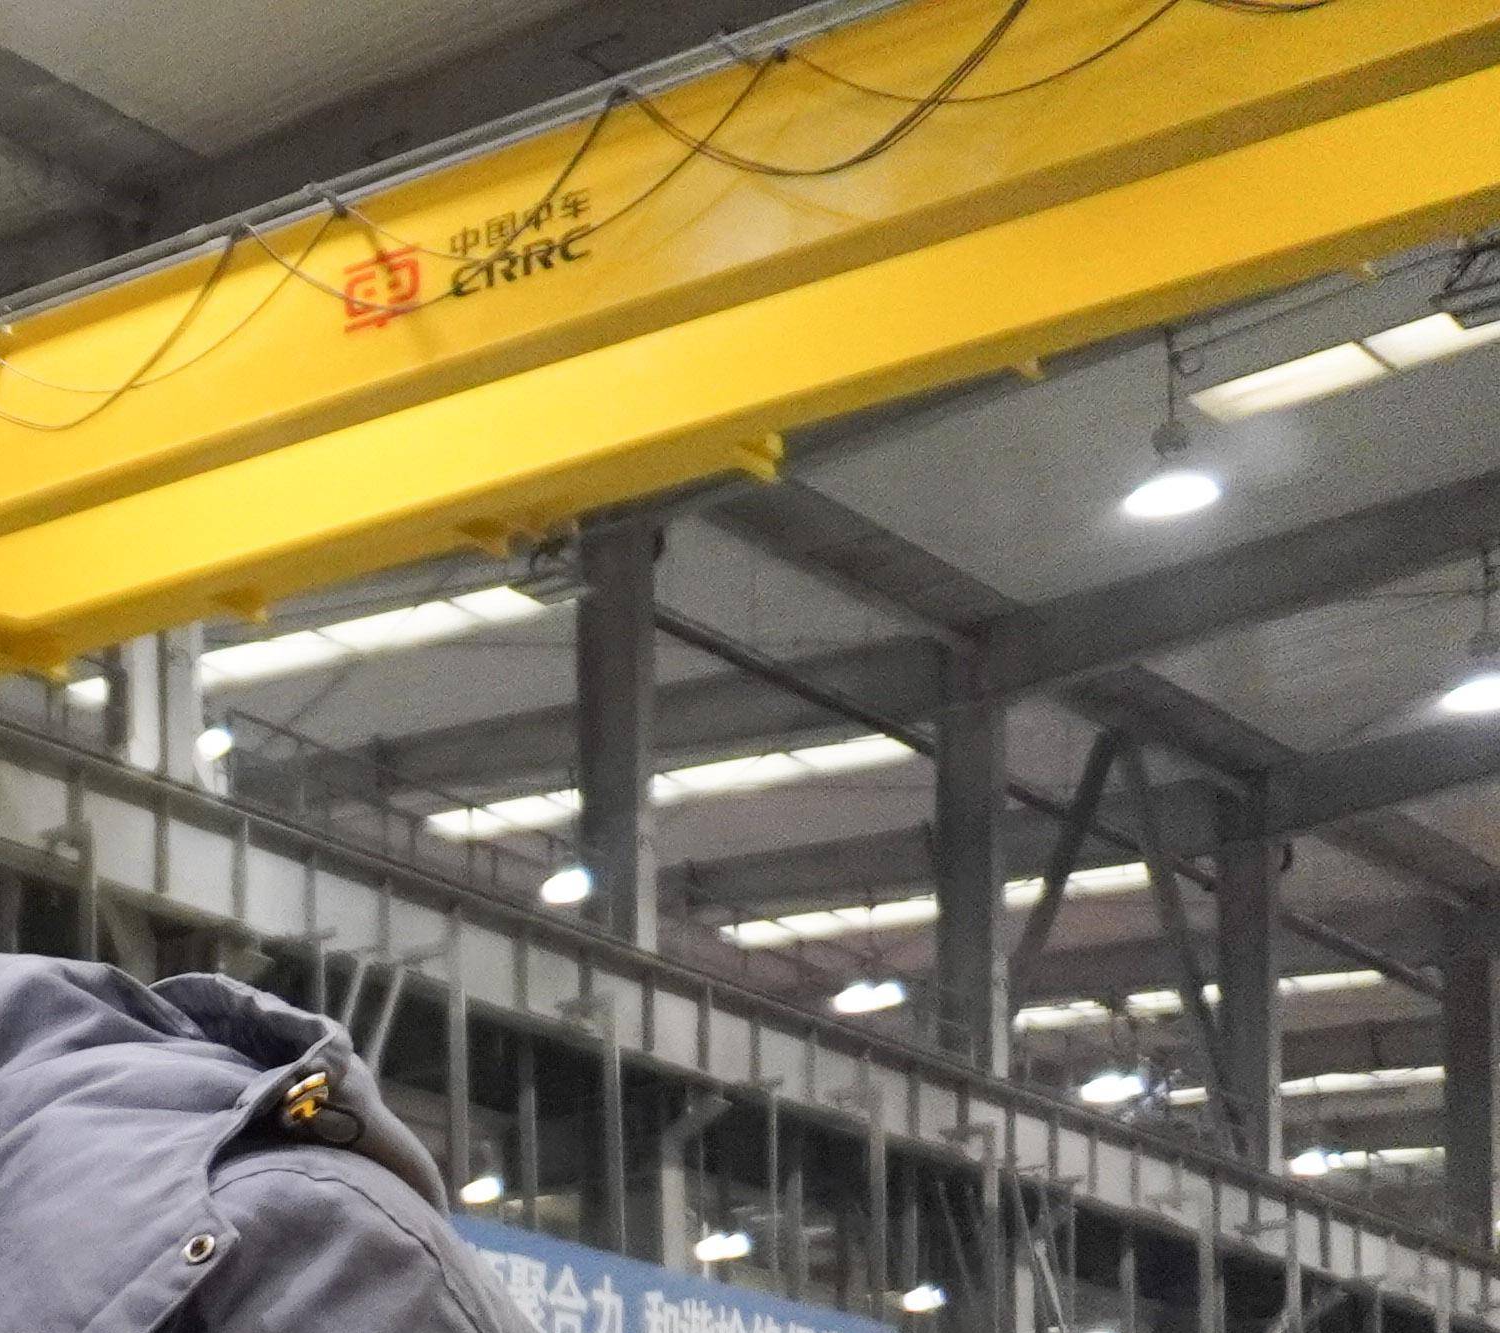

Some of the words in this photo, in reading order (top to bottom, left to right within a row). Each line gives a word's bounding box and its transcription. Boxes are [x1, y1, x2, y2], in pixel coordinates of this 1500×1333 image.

[450, 188, 592, 256] 中国中车
[452, 223, 592, 297] CRRC
